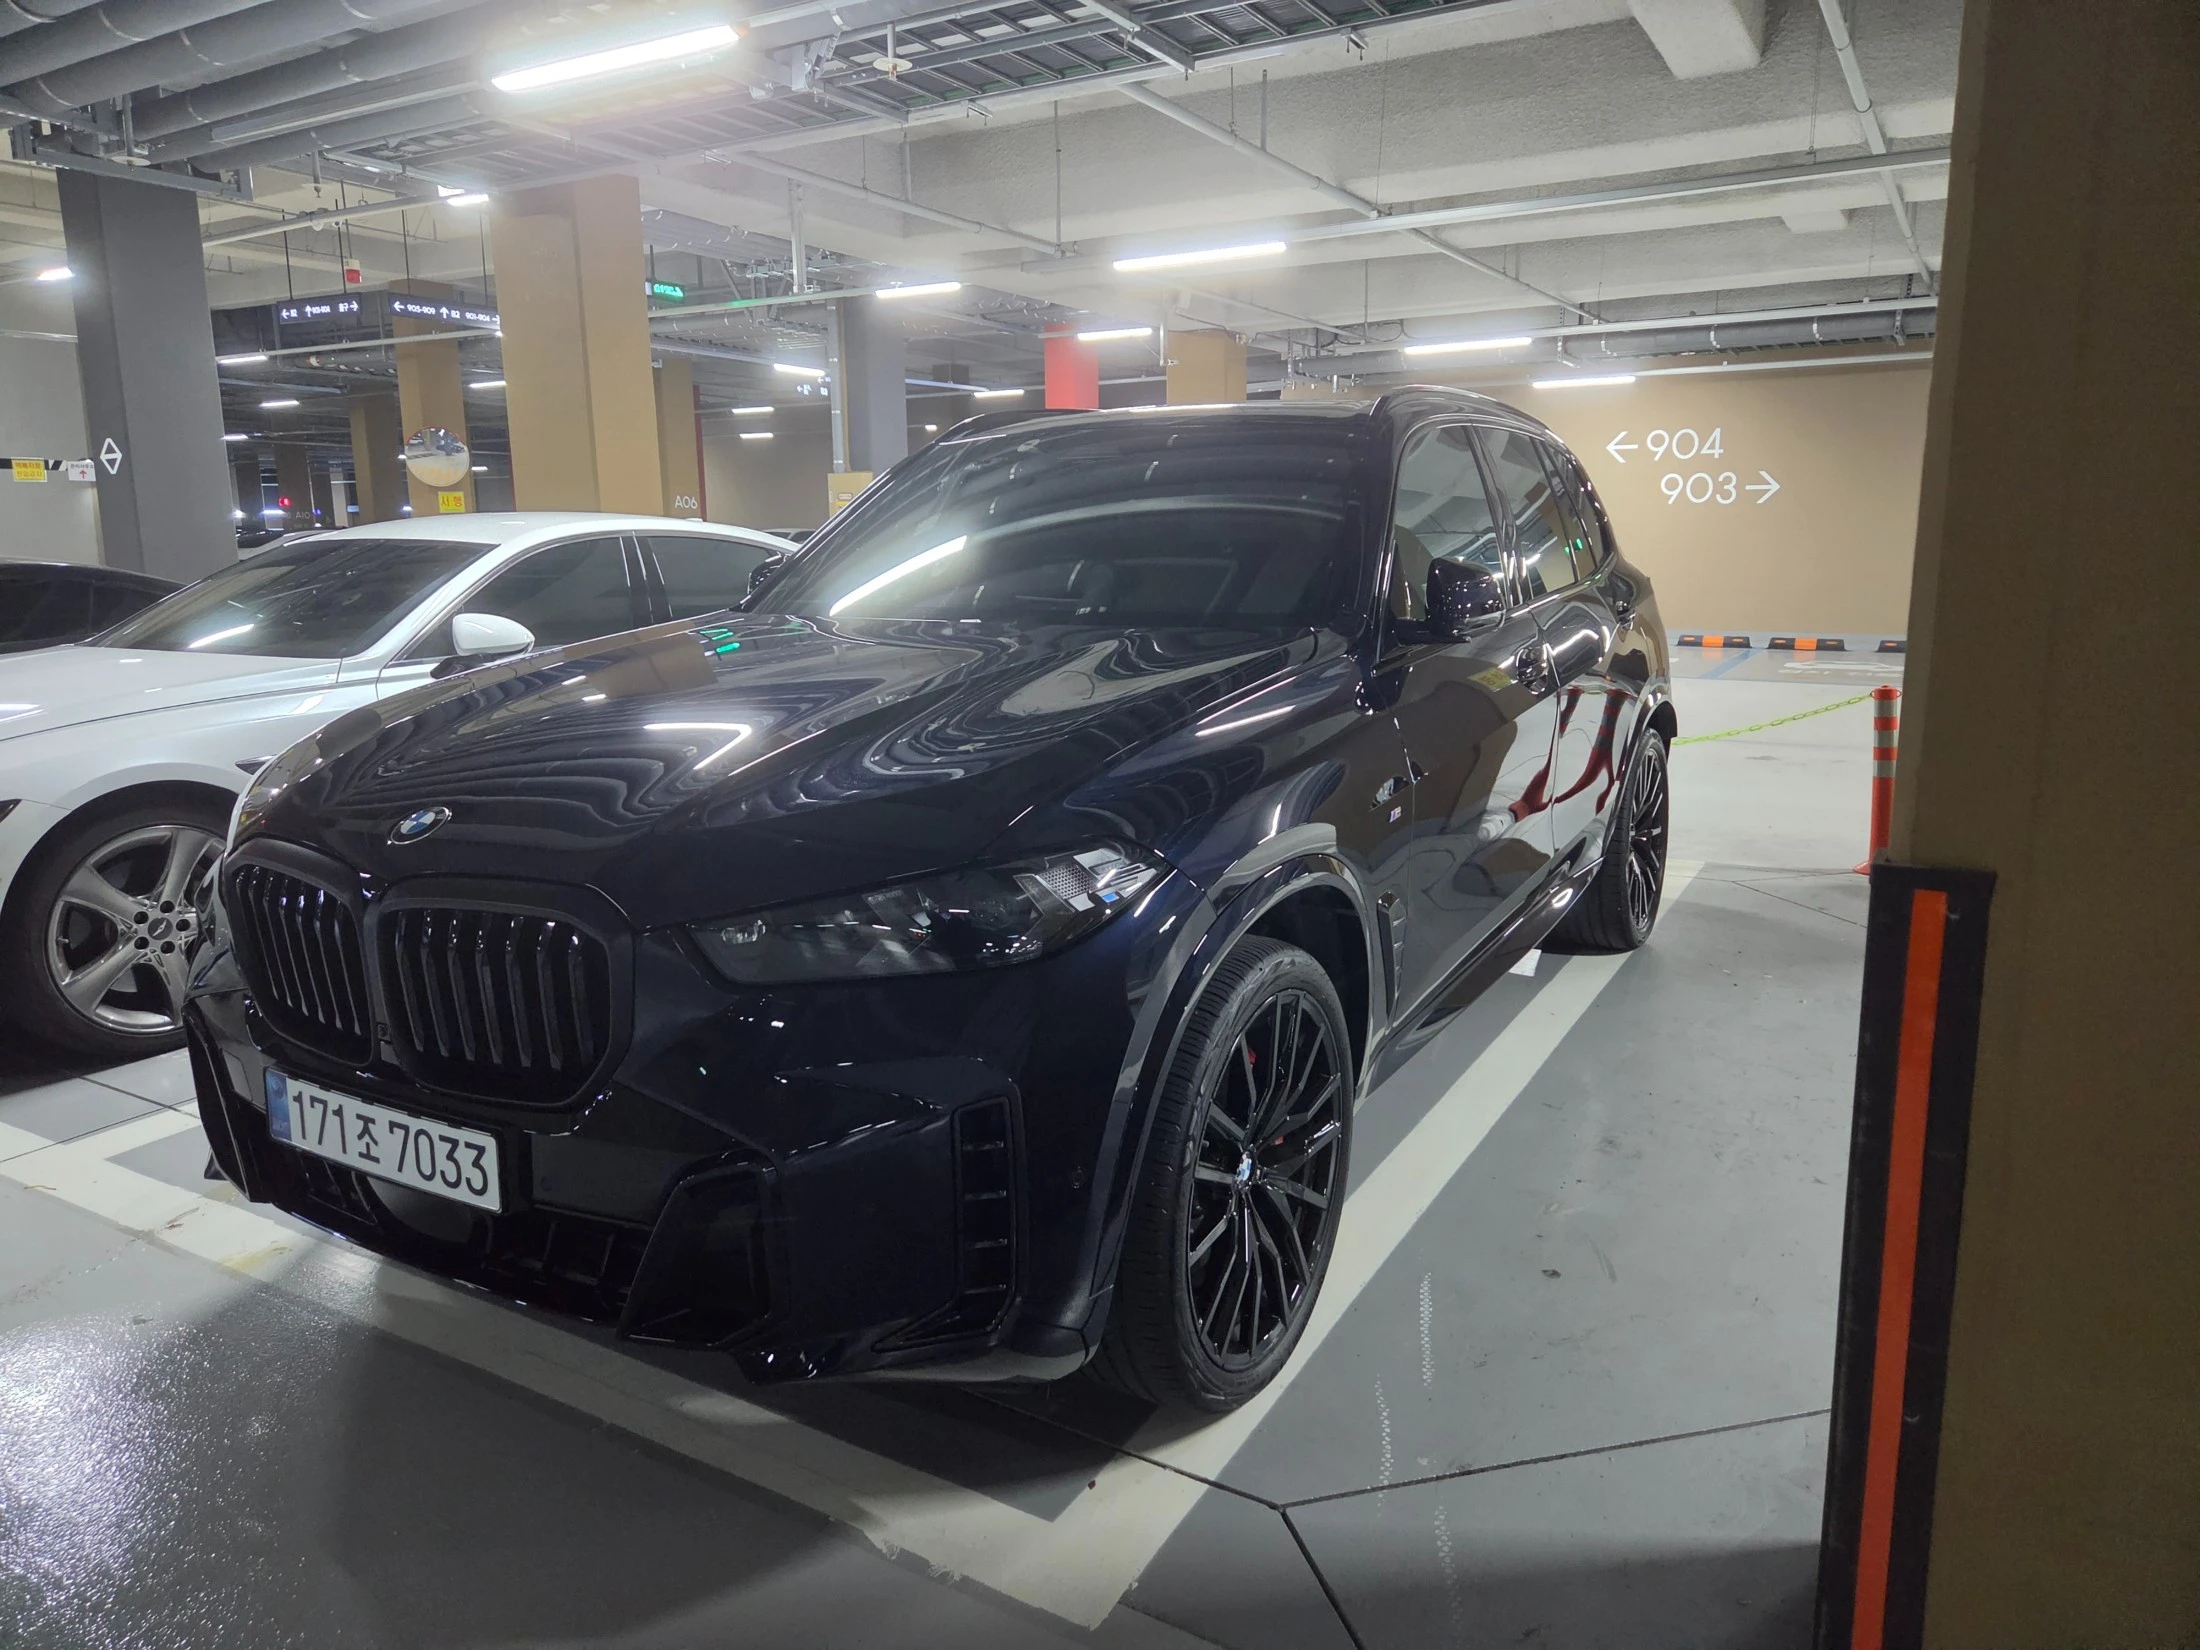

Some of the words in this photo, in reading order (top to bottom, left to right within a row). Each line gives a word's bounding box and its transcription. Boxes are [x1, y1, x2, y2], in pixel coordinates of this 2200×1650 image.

[451, 310, 460, 319] B2
[1646, 427, 1724, 460] 904
[1660, 471, 1737, 505] 903
[674, 495, 698, 509] A06
